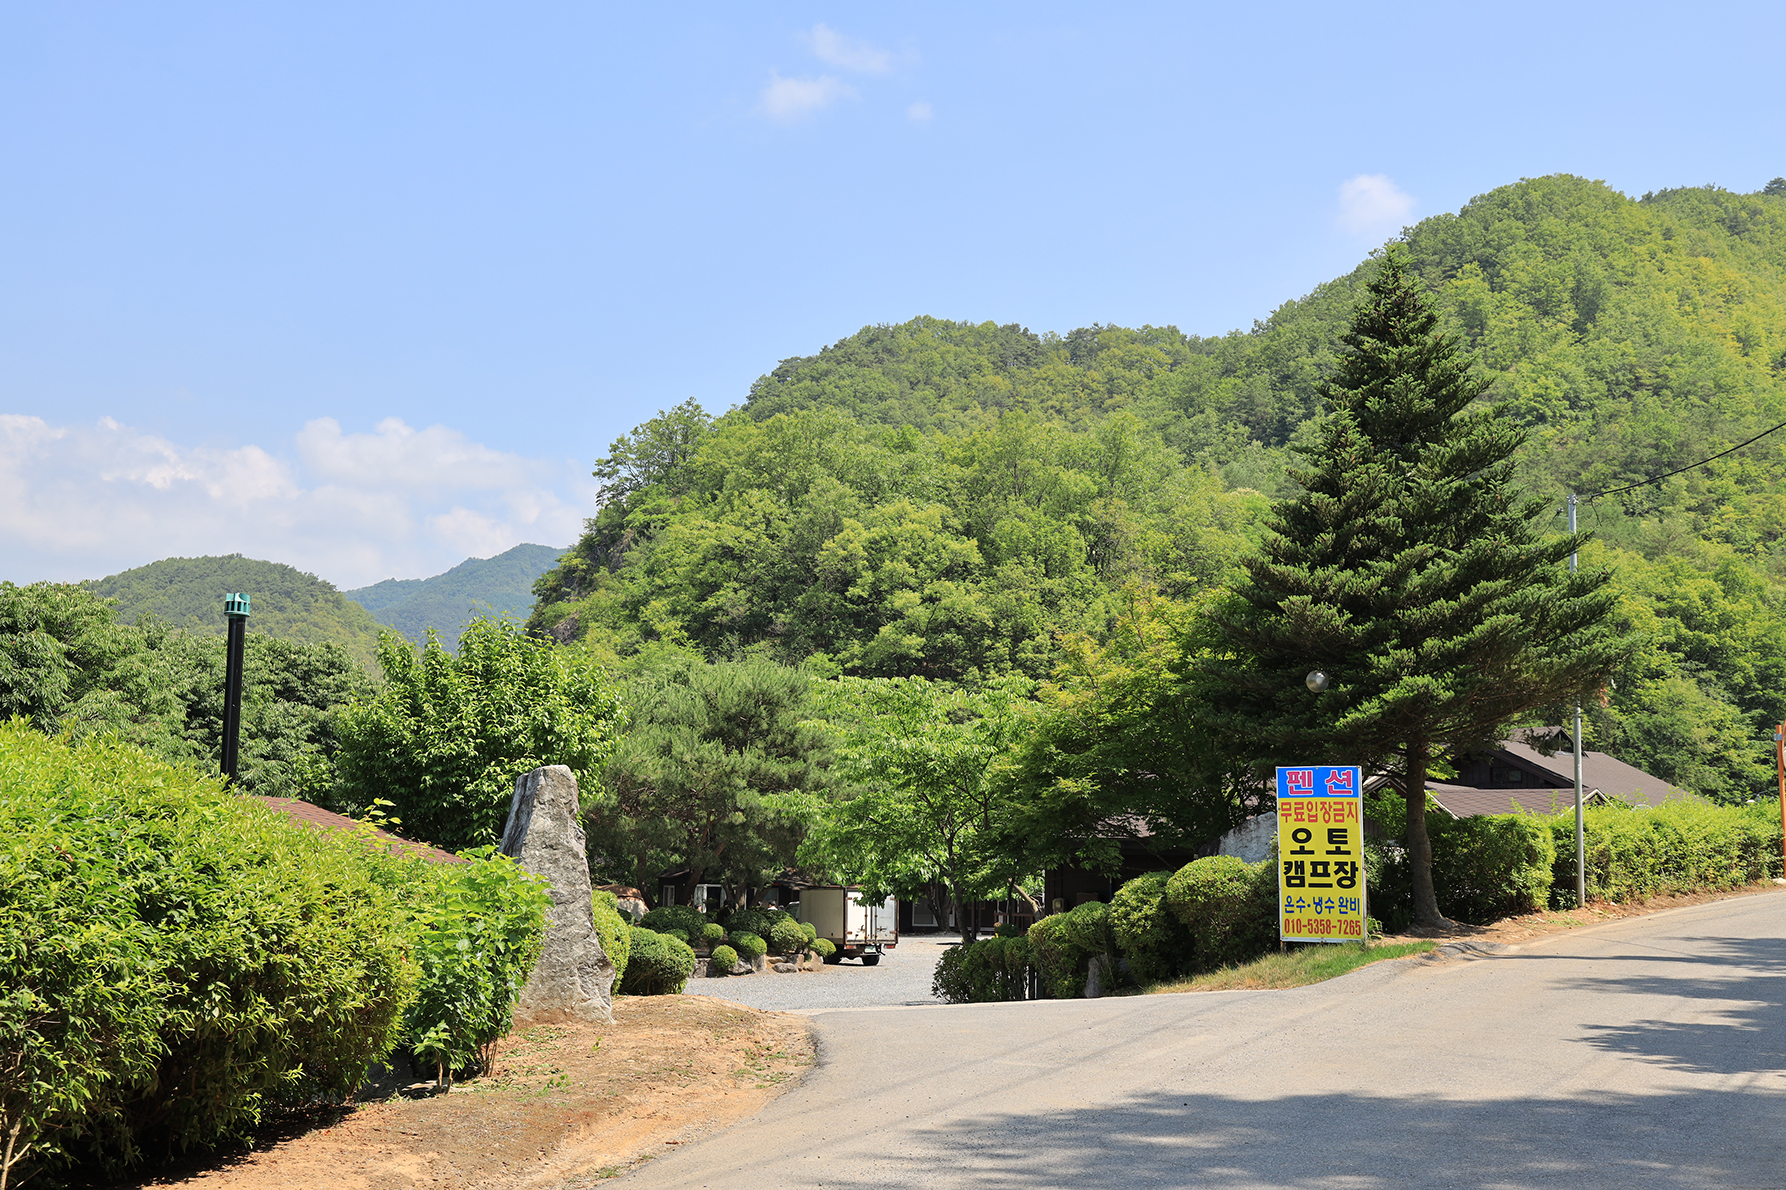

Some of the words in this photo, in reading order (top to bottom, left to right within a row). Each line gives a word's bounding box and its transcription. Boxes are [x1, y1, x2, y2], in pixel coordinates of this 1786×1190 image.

[1281, 801, 1358, 823] 무료입장금지
[1283, 861, 1359, 889] 캠프장
[1338, 896, 1360, 915] 완비
[1284, 918, 1361, 936] 010-5358-7265
